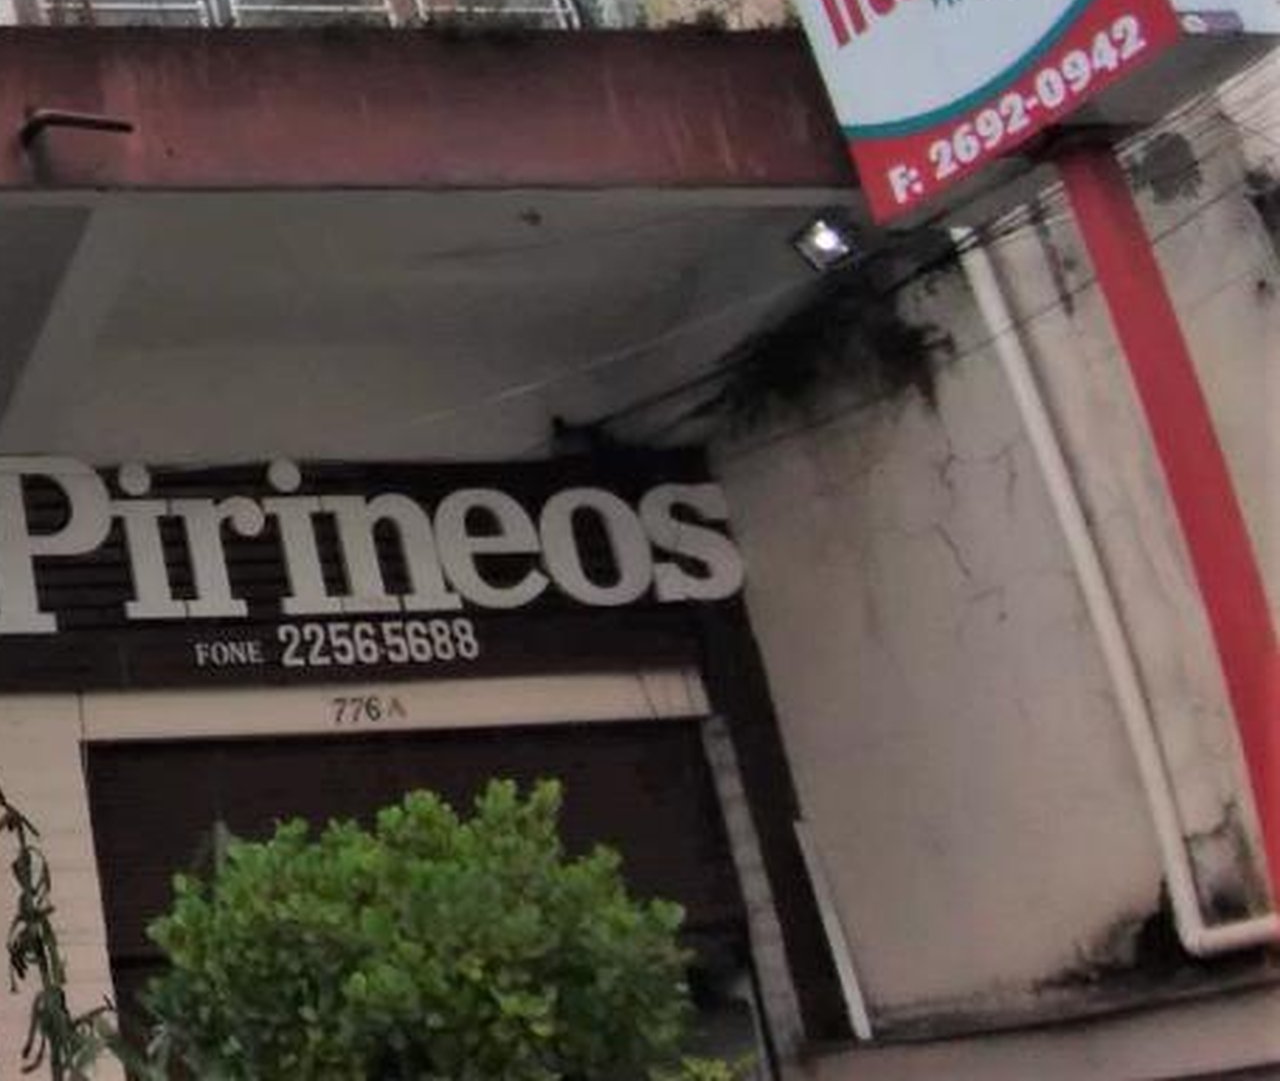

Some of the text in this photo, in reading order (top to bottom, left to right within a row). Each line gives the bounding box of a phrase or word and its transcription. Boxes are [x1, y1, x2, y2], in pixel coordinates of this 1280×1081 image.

[886, 14, 1146, 203] F: 2692-0942
[194, 641, 264, 667] FONE
[332, 697, 382, 723] 776
